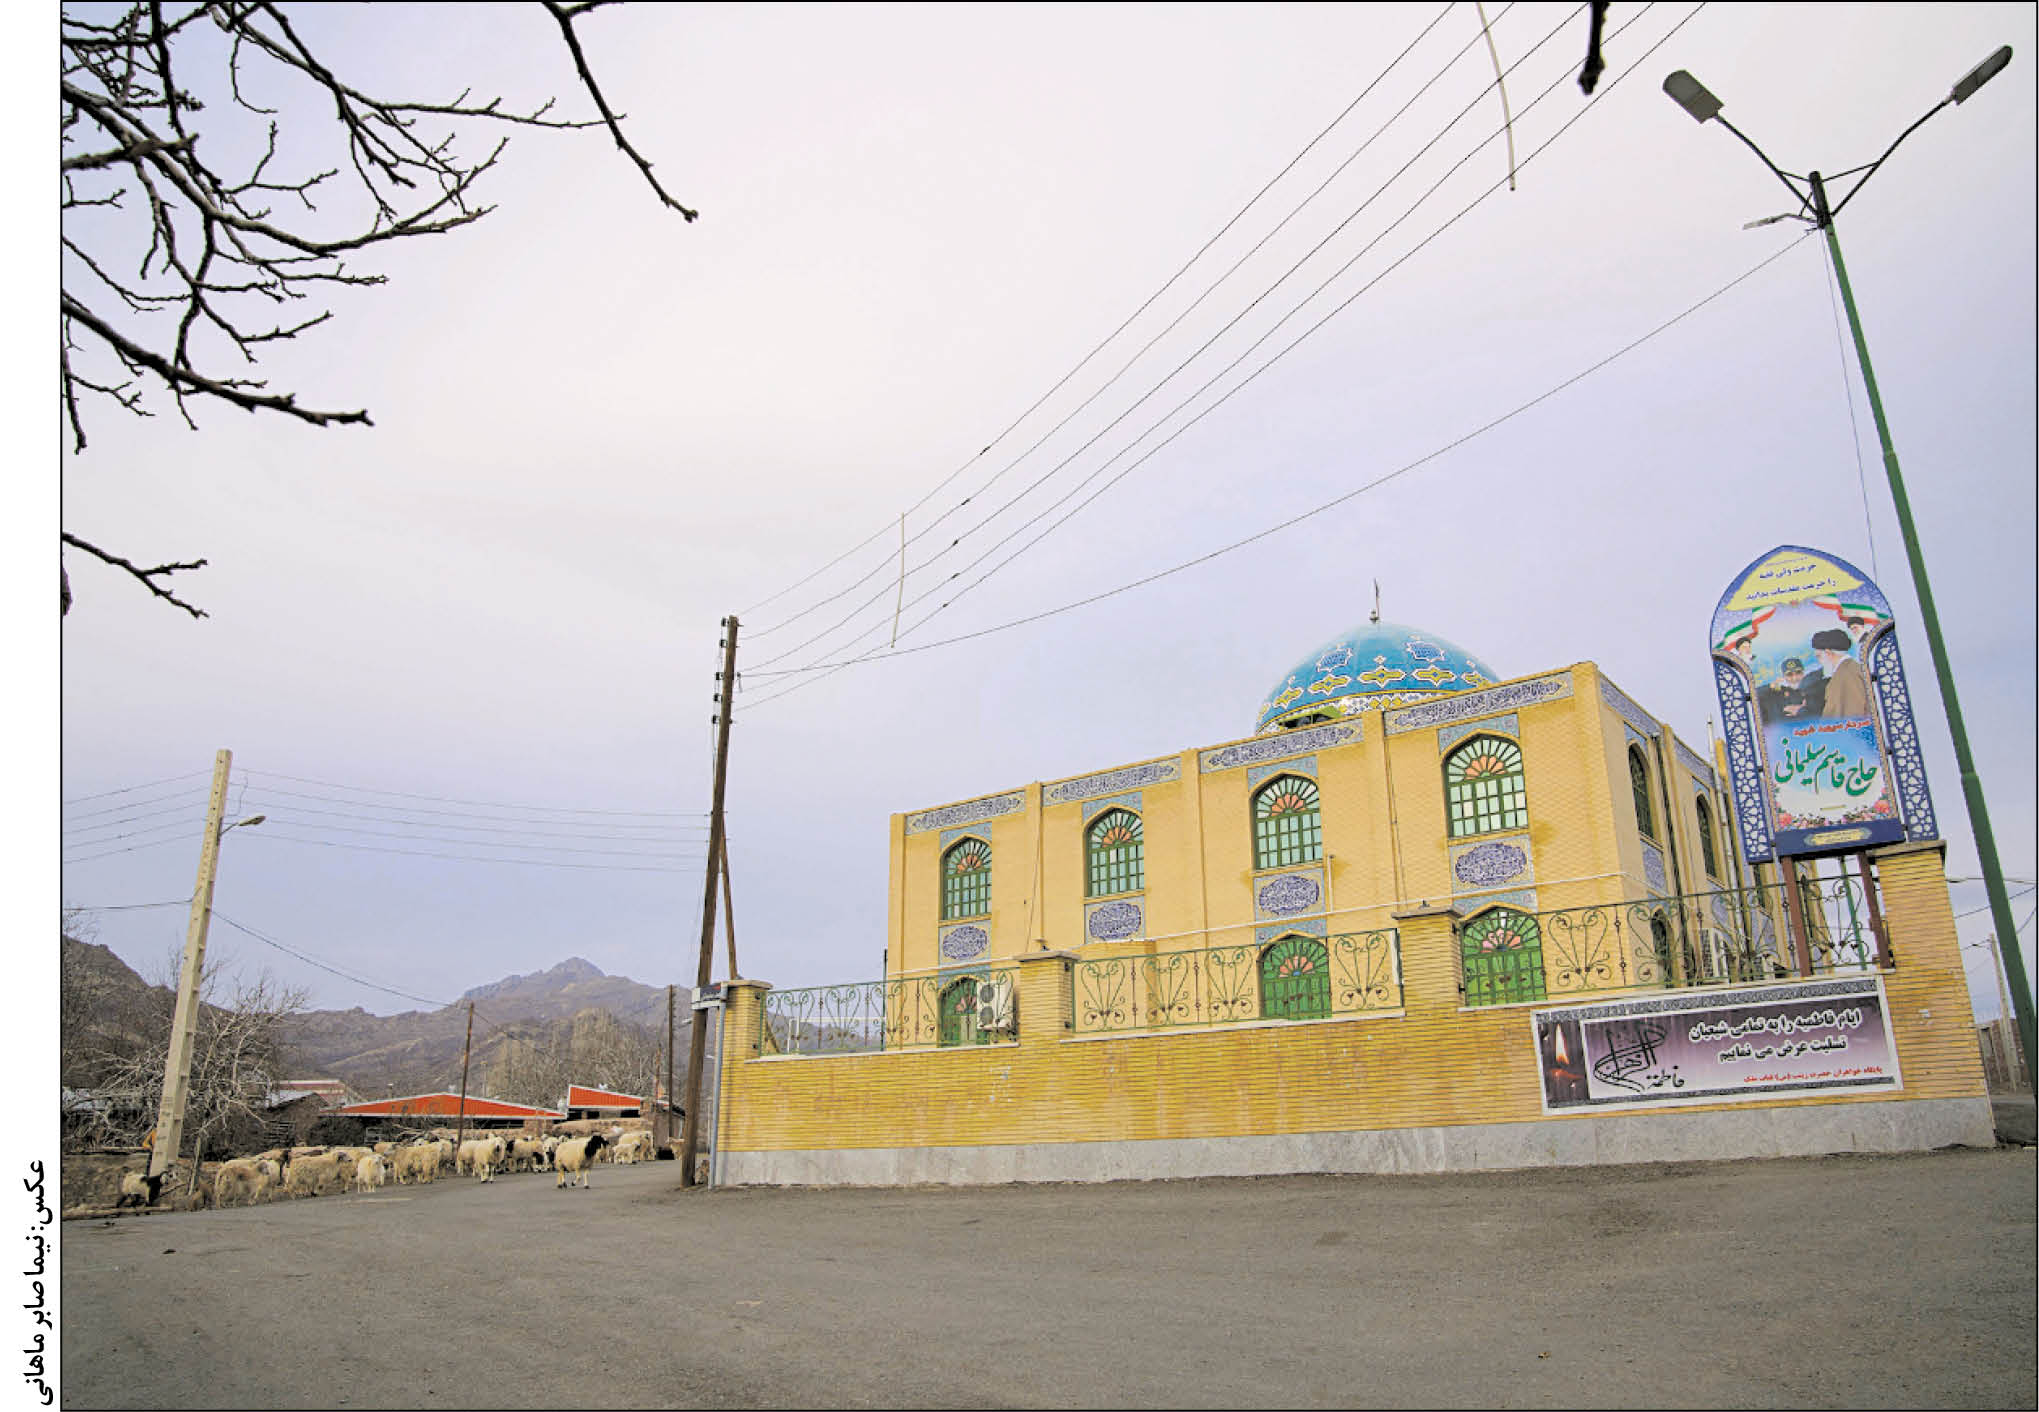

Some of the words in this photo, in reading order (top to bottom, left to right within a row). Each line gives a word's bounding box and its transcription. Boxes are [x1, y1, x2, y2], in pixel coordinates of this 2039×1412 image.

[1826, 576, 1836, 587] را
[1774, 737, 1826, 786] سلیمانی
[1815, 749, 1845, 795] قاسم
[1845, 757, 1878, 796] حاج
[1731, 1015, 1765, 1037] تمامی
[1768, 1017, 1781, 1033] به
[1781, 1014, 1794, 1033] را
[1796, 1010, 1834, 1031] فاطمیه
[1838, 1009, 1861, 1027] ایام
[1690, 1020, 1727, 1041] شیعیان
[1778, 1039, 1808, 1058] عرض
[1811, 1034, 1848, 1053] تسلیت
[1755, 1047, 1774, 1060] می
